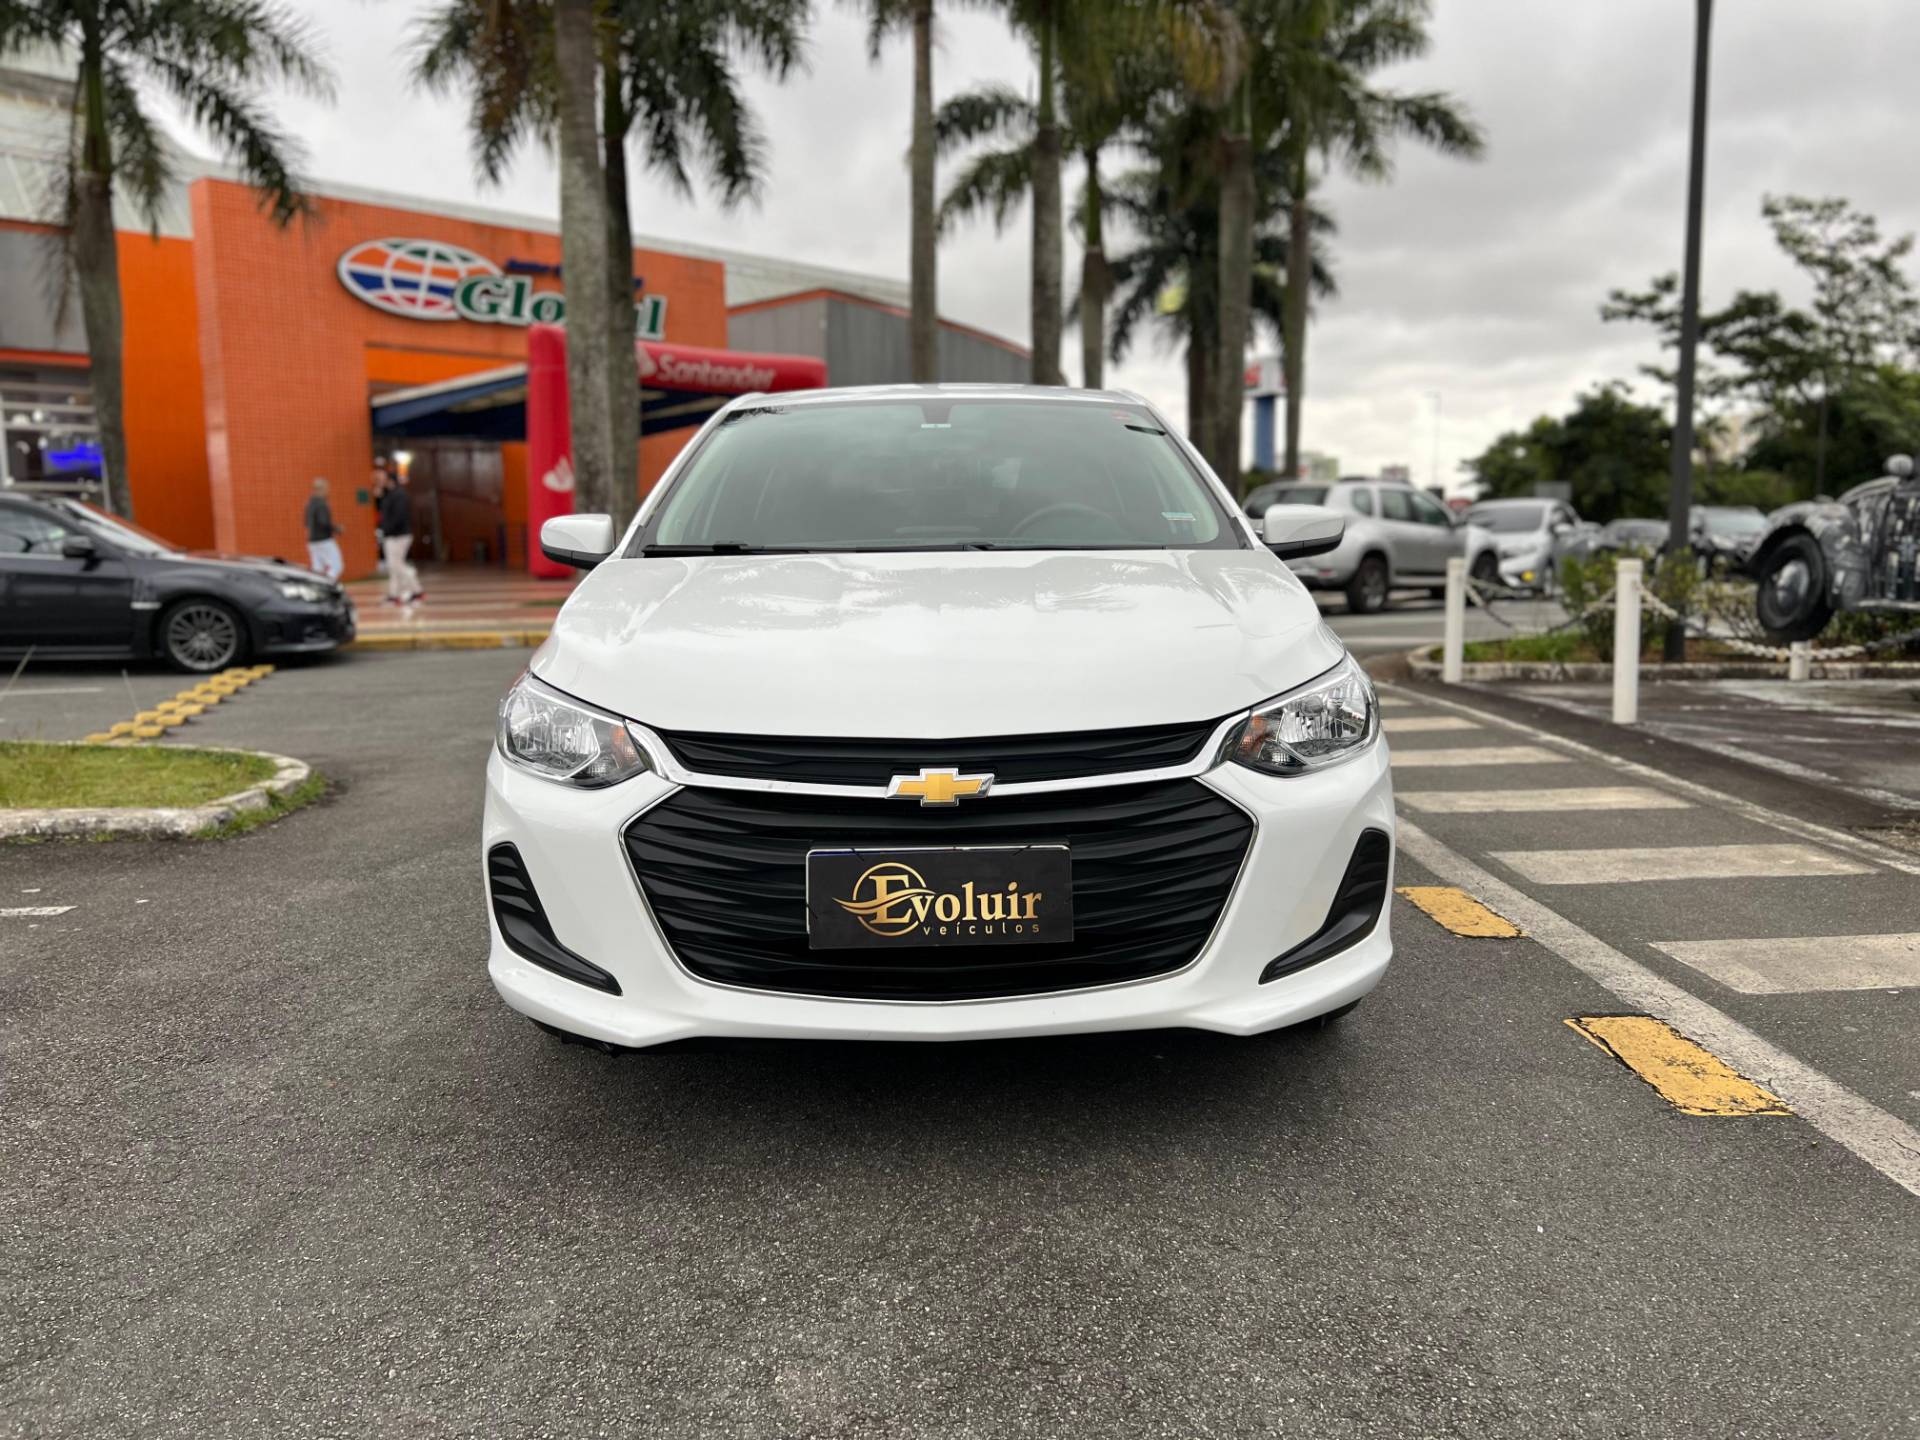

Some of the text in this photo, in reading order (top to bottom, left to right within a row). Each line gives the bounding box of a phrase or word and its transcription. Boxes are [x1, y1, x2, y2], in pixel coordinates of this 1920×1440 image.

[455, 275, 667, 340] Glol
[657, 352, 775, 389] Santander
[868, 874, 1042, 924] Evoluir
[923, 921, 1040, 935] veículos
